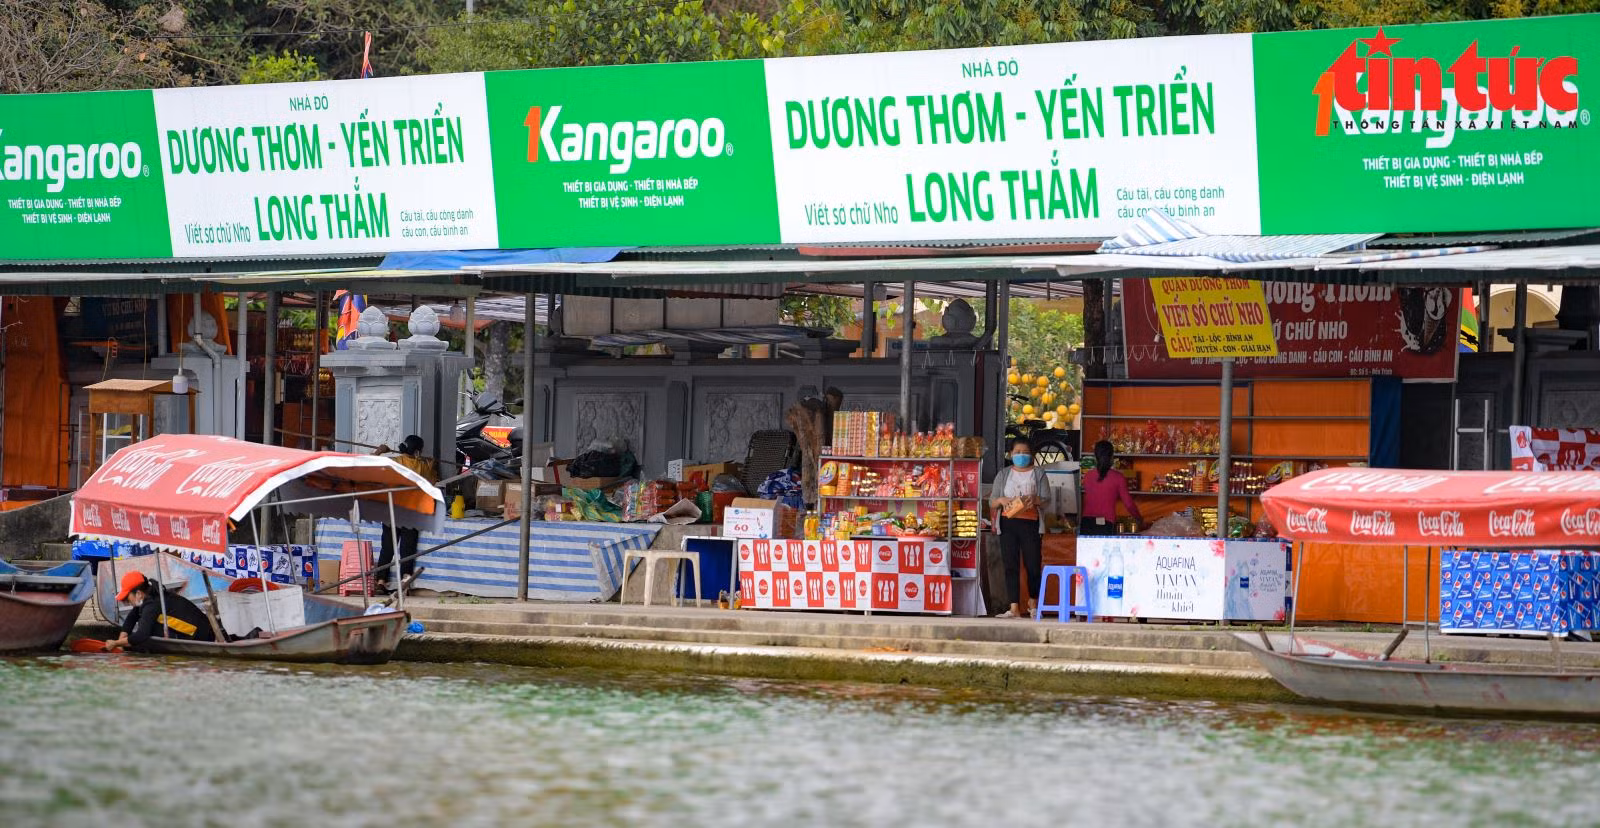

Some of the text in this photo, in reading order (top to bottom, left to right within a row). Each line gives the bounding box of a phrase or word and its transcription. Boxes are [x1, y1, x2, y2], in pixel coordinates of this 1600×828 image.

[962, 60, 994, 78] NHÀ
[289, 94, 311, 111] NHÀ
[785, 96, 900, 149] DƯƠNG
[906, 90, 1006, 144] THƠM
[1034, 73, 1105, 140] YẾN
[1113, 65, 1215, 137] TRIỂN
[166, 126, 249, 174] DƯƠNG
[252, 122, 323, 171] THƠM
[340, 108, 390, 167] YẾN
[393, 102, 464, 165] TRIỂN
[0, 128, 142, 193] angaroo
[1362, 150, 1543, 172] THIẾT BỊ GIA DỤNG THIẾT BỊ NHÀ BẾP
[562, 180, 583, 192] THIẾT
[594, 181, 607, 192] GIA
[607, 181, 628, 194] DỤNG
[634, 177, 655, 190] THIẾT
[665, 177, 683, 190] NHÀ
[683, 176, 698, 189] BẾP
[905, 149, 1100, 222] LONG THẮM
[1384, 171, 1524, 190] THIẾT BỊ VỆ SINH ĐIỆN LẠNH
[1200, 186, 1225, 199] danh
[254, 176, 390, 241] LONG THẮM
[578, 195, 600, 208] THIẾT
[610, 195, 620, 211] VỆ
[621, 197, 638, 208] SINH
[643, 194, 662, 208] ĐIỆN
[663, 195, 685, 208] LẠNH
[1203, 206, 1215, 216] an
[456, 208, 474, 220] danh
[873, 200, 899, 225] Nho
[232, 222, 251, 242] Nho
[459, 227, 469, 236] an
[1210, 296, 1235, 326] CHỮ
[1236, 302, 1264, 325] NHO
[1244, 333, 1254, 342] AN
[1285, 318, 1315, 340] CHỮ
[1318, 320, 1348, 340] NHO
[1289, 351, 1308, 363] DANH
[1328, 350, 1343, 362] CON
[1383, 349, 1393, 362] AN
[1156, 556, 1197, 571] AQUAFINA
